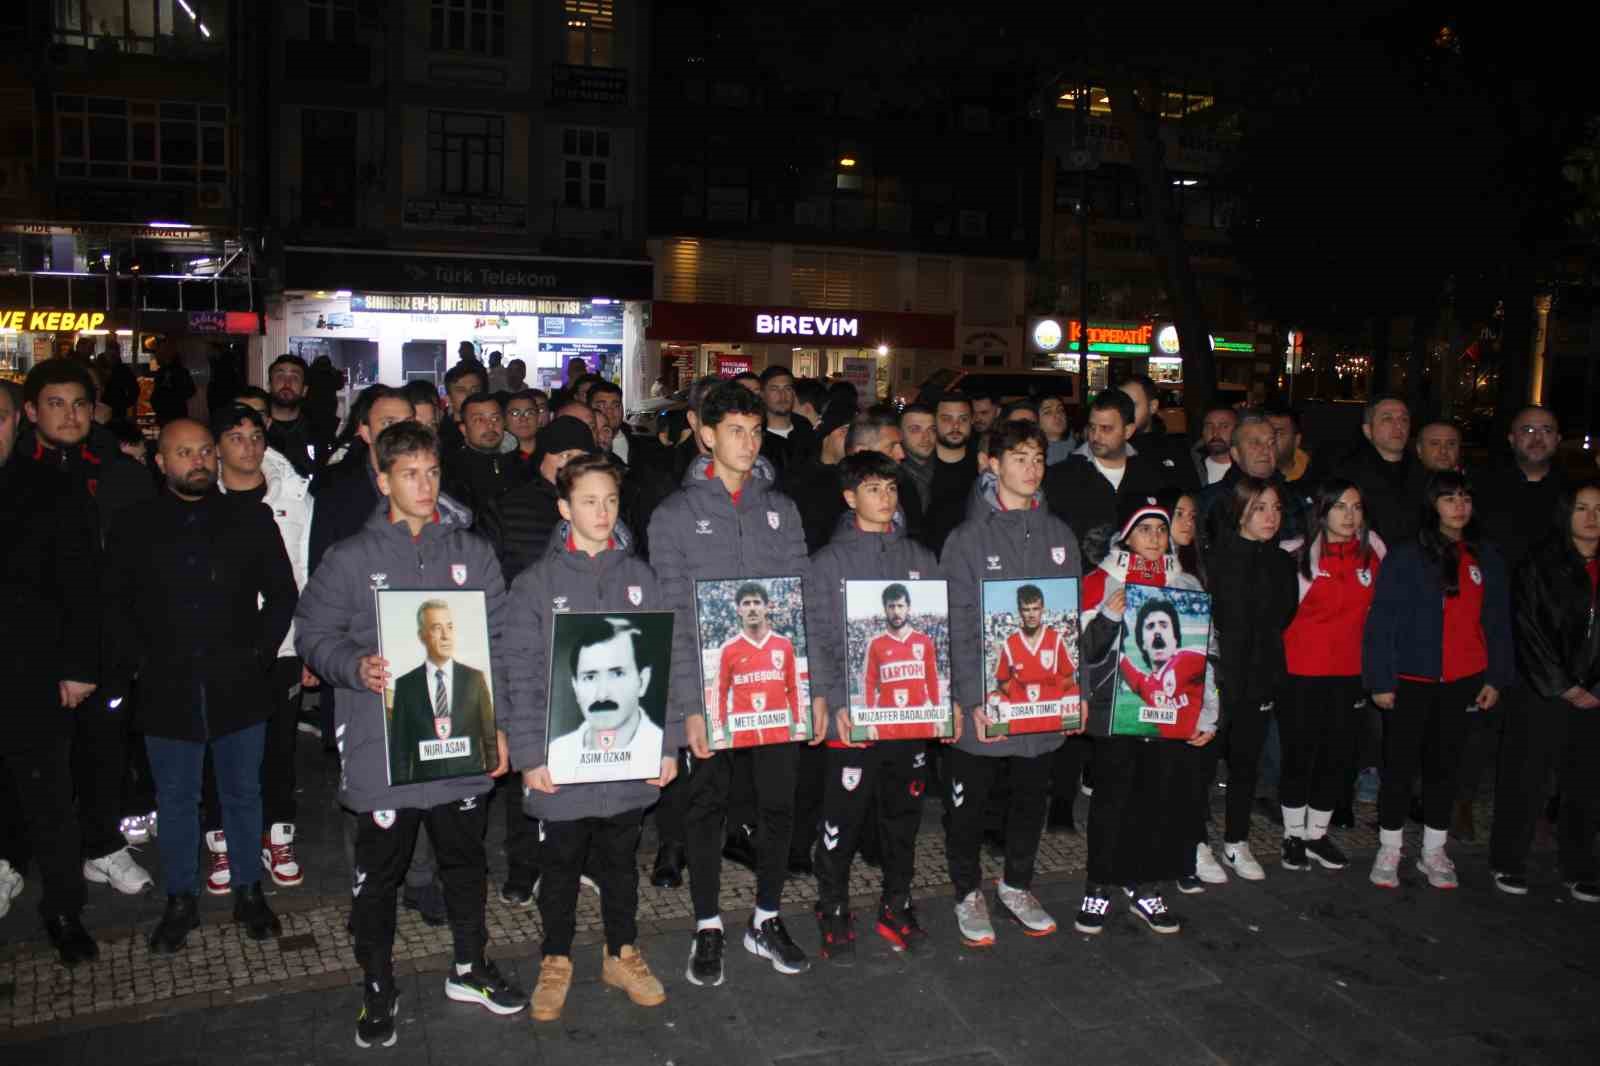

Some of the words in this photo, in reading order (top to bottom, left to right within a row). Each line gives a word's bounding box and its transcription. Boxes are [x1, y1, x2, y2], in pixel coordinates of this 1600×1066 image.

[480, 267, 558, 288] Telekom
[30, 312, 105, 331] KEBAP
[858, 710, 898, 722] MUZAFFER
[1010, 704, 1034, 717] ZORAN
[735, 715, 756, 729] METE
[758, 712, 786, 725] ADANIR
[445, 740, 466, 754] ASAN
